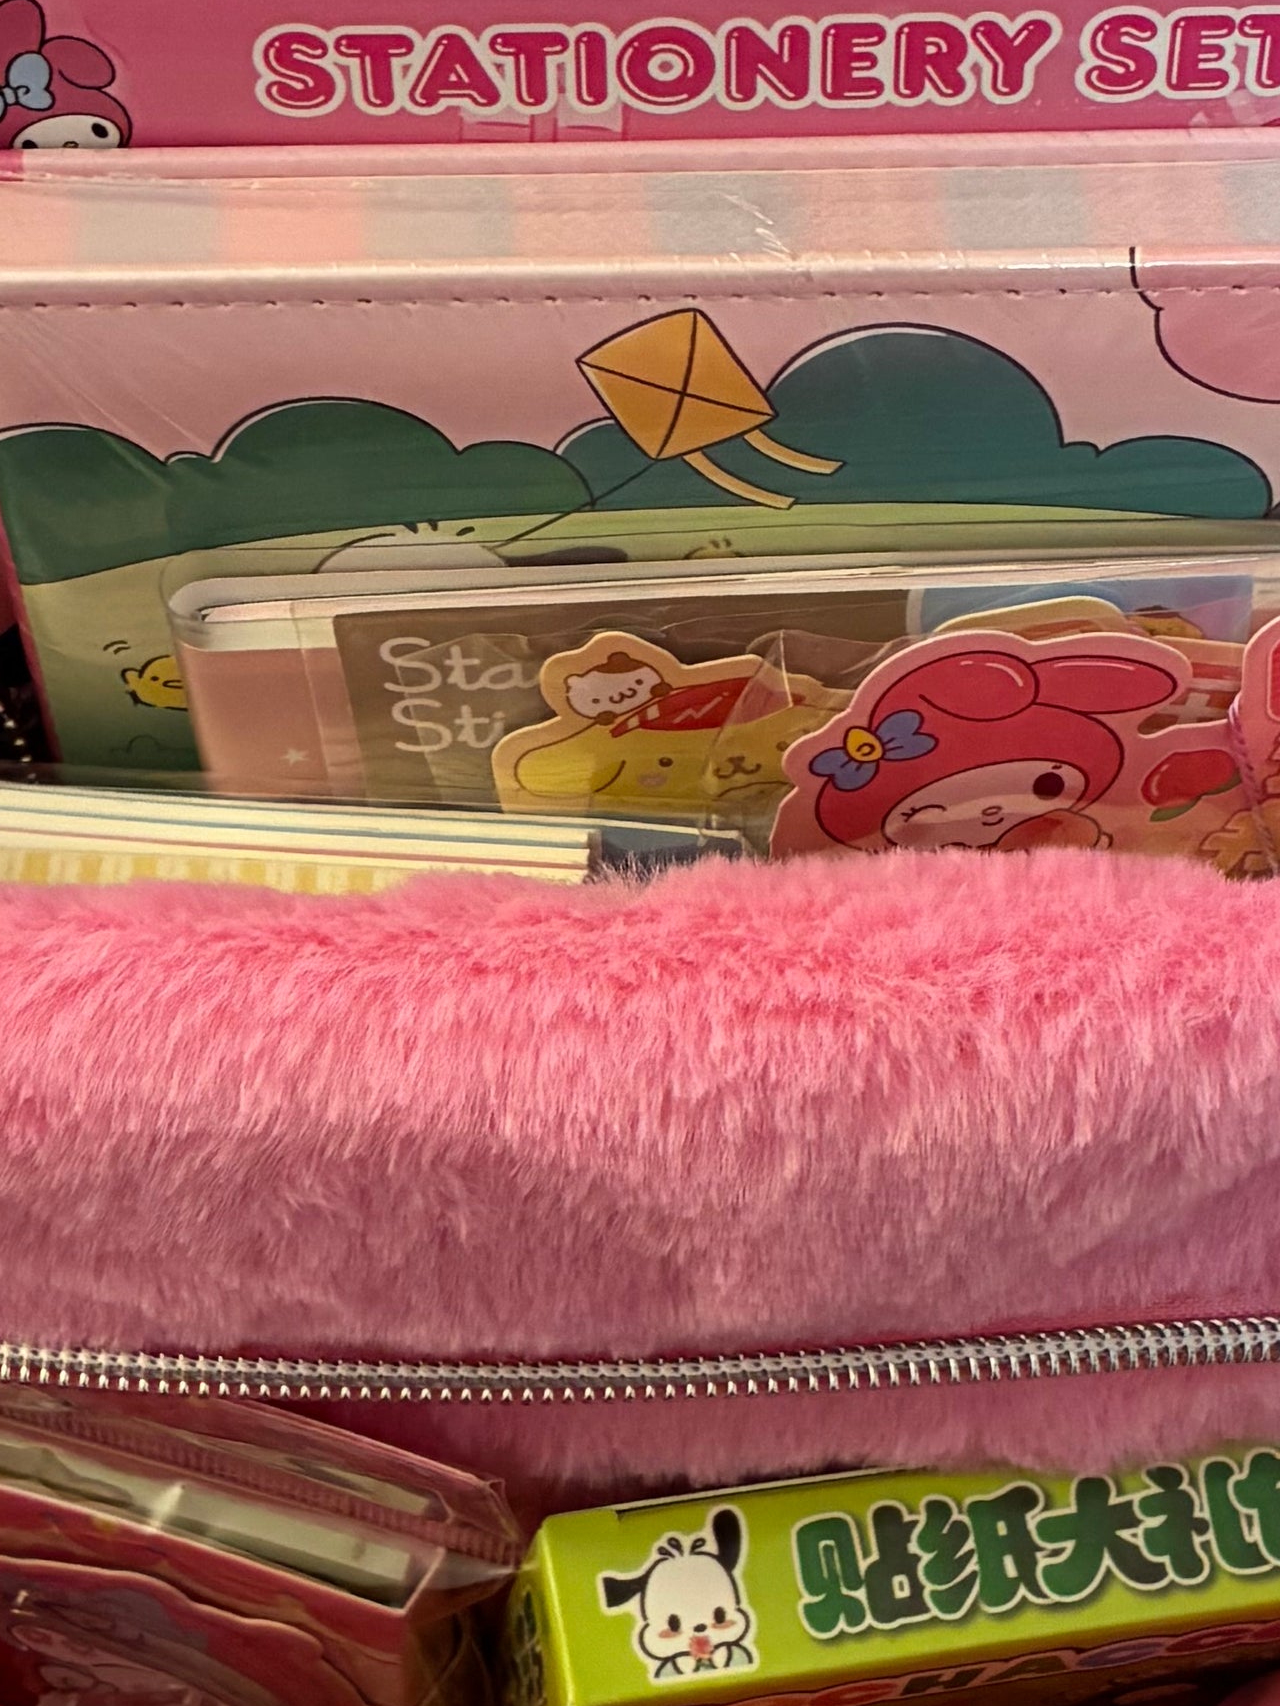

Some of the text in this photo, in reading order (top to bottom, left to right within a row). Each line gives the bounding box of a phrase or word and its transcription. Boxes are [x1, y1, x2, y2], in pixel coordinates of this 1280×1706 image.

[257, 13, 1060, 114] STATIONERY
[379, 636, 540, 694] Sta
[391, 698, 507, 753] Sti
